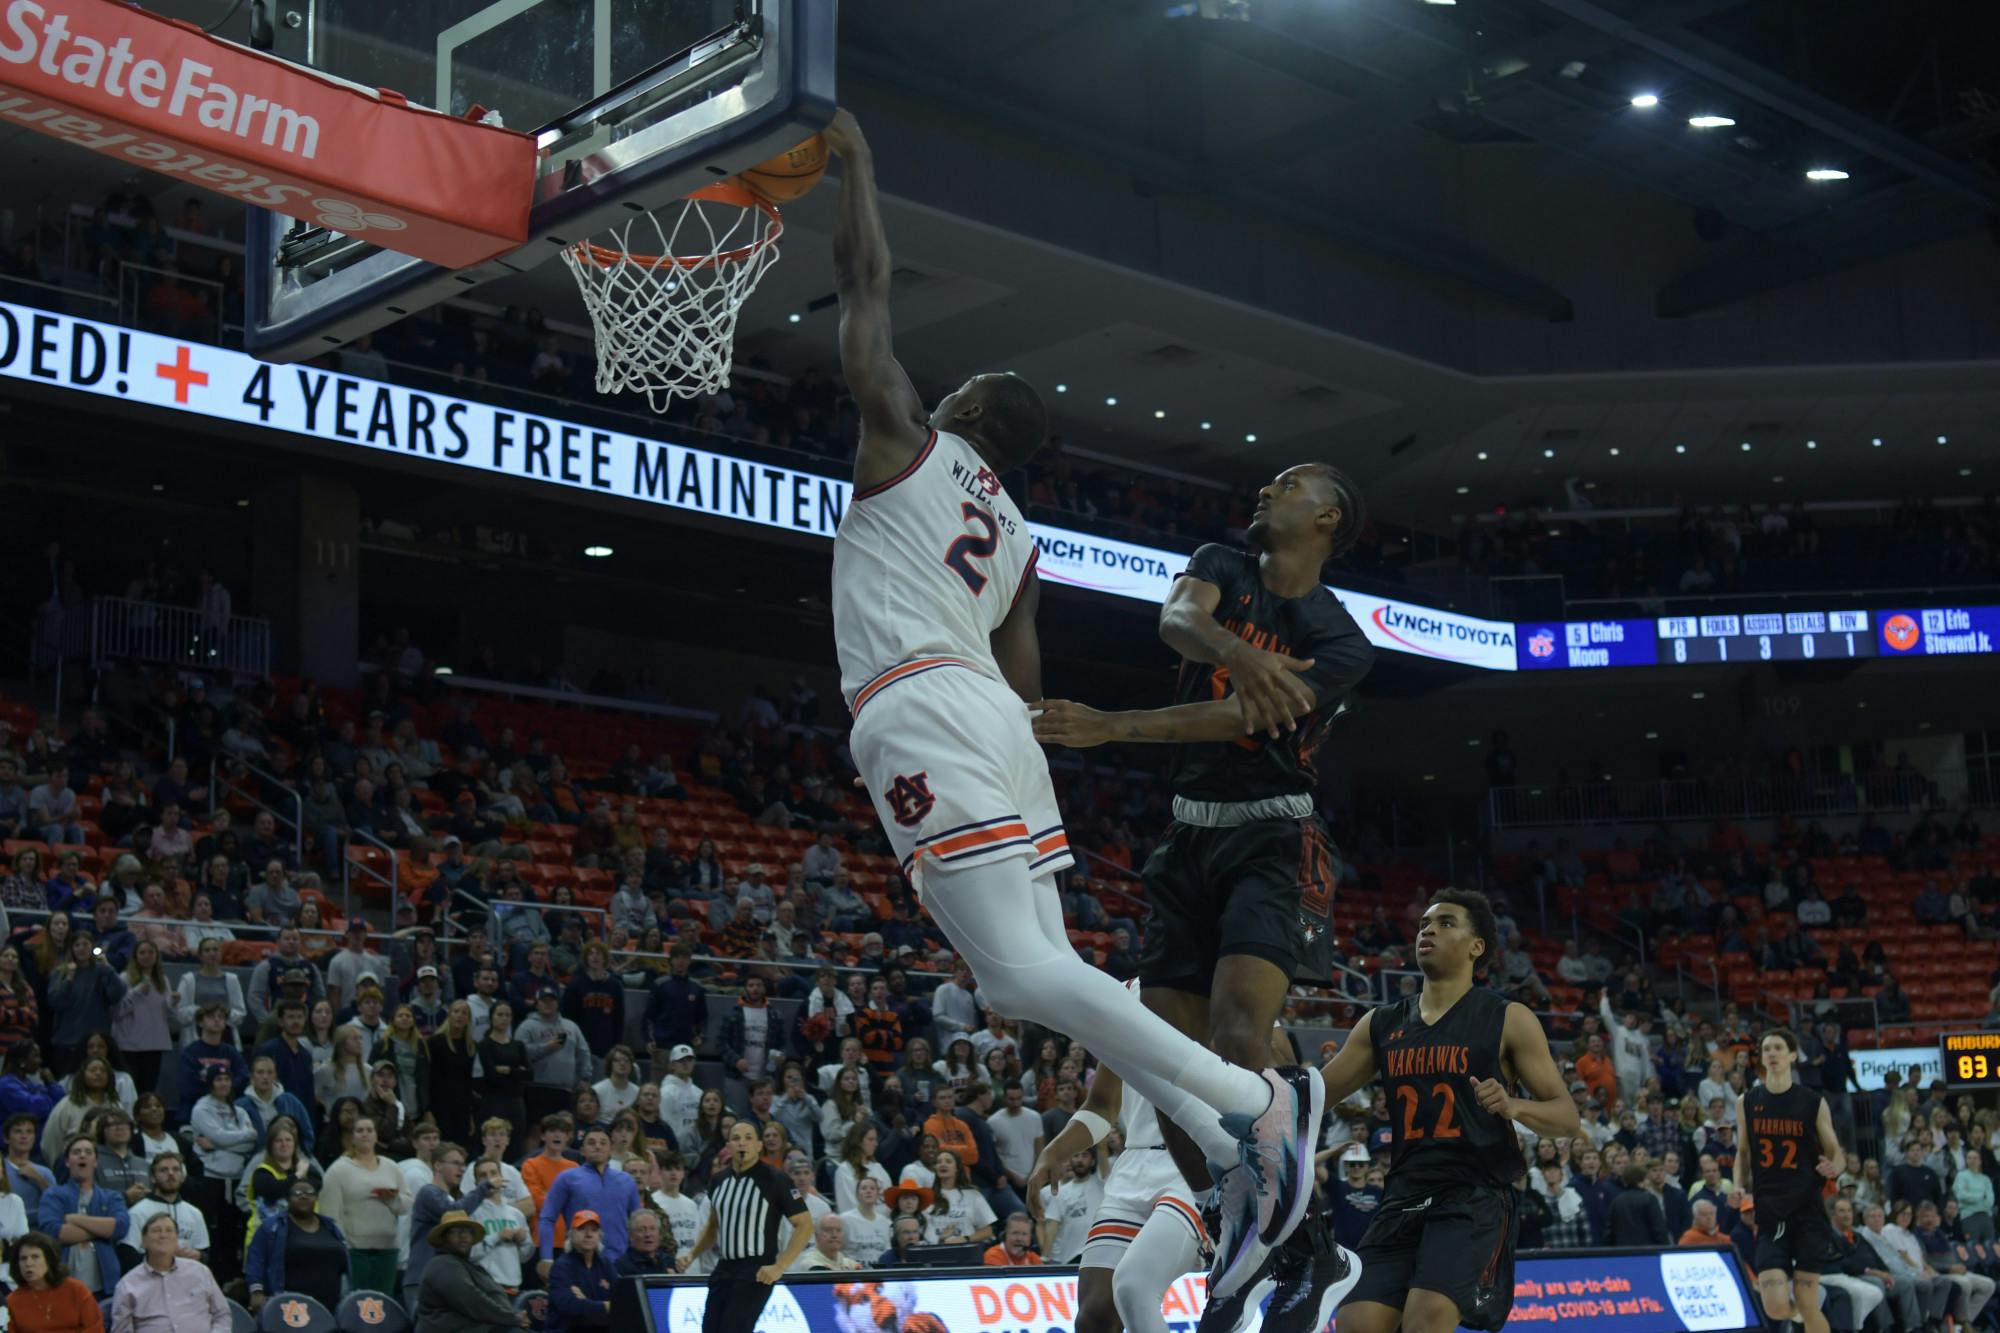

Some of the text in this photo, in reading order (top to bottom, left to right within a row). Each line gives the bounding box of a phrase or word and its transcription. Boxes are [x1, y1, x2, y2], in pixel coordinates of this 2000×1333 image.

[242, 364, 275, 422] 4
[298, 369, 470, 460] YEARS
[493, 411, 611, 489] FREE
[943, 501, 999, 599] 2
[1090, 546, 1169, 579] TOYOTA
[1384, 604, 1442, 637] LYNCH
[1446, 622, 1513, 648] TOYOTA
[1574, 621, 1624, 643] 5 Chris
[1569, 647, 1609, 668] Moore
[1674, 633, 1855, 664] 8 1 3 0 1
[1387, 1045, 1469, 1078] WARHAWKS
[1861, 1058, 1939, 1077] Piedmnt
[1958, 1055, 1988, 1079] 83
[1396, 1082, 1462, 1141] 22
[1753, 1118, 1804, 1137] WARHAWKS
[1759, 1139, 1798, 1169] 32
[1669, 1265, 1726, 1282] ALABAMA
[1546, 1282, 1566, 1296] are
[1567, 1275, 1631, 1296] up-to-date
[1675, 1284, 1718, 1300] PUBLIC
[1558, 1299, 1616, 1319] COVID-19
[1617, 1296, 1641, 1315] and
[1681, 1303, 1728, 1320] HEALTH
